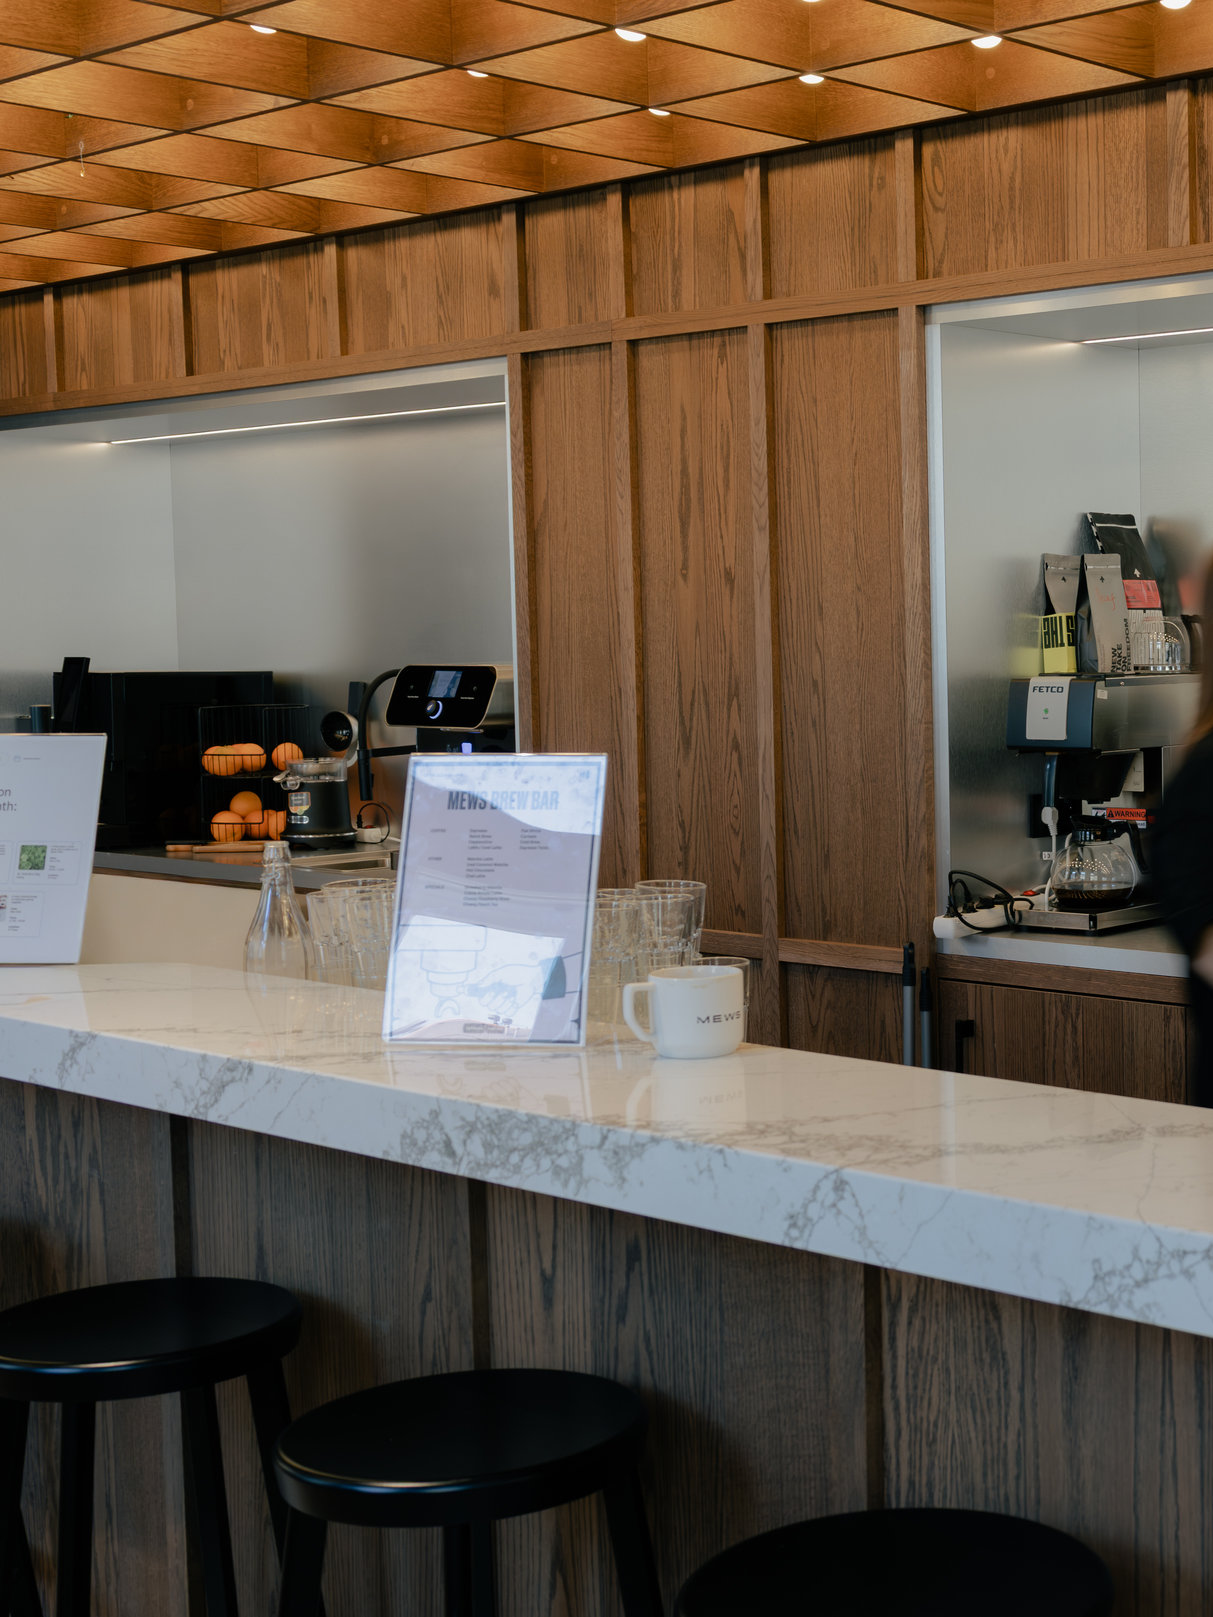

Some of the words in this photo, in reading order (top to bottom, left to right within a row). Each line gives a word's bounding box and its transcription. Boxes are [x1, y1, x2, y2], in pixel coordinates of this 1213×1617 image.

[1124, 618, 1132, 672] FREEDOM
[1121, 655, 1127, 672] ON
[1032, 685, 1064, 693] FETCO
[447, 791, 488, 810] MEWS
[490, 791, 528, 810] BREW
[531, 791, 559, 810] BAR
[1114, 810, 1145, 818] WARNING
[696, 1010, 741, 1024] MEWS
